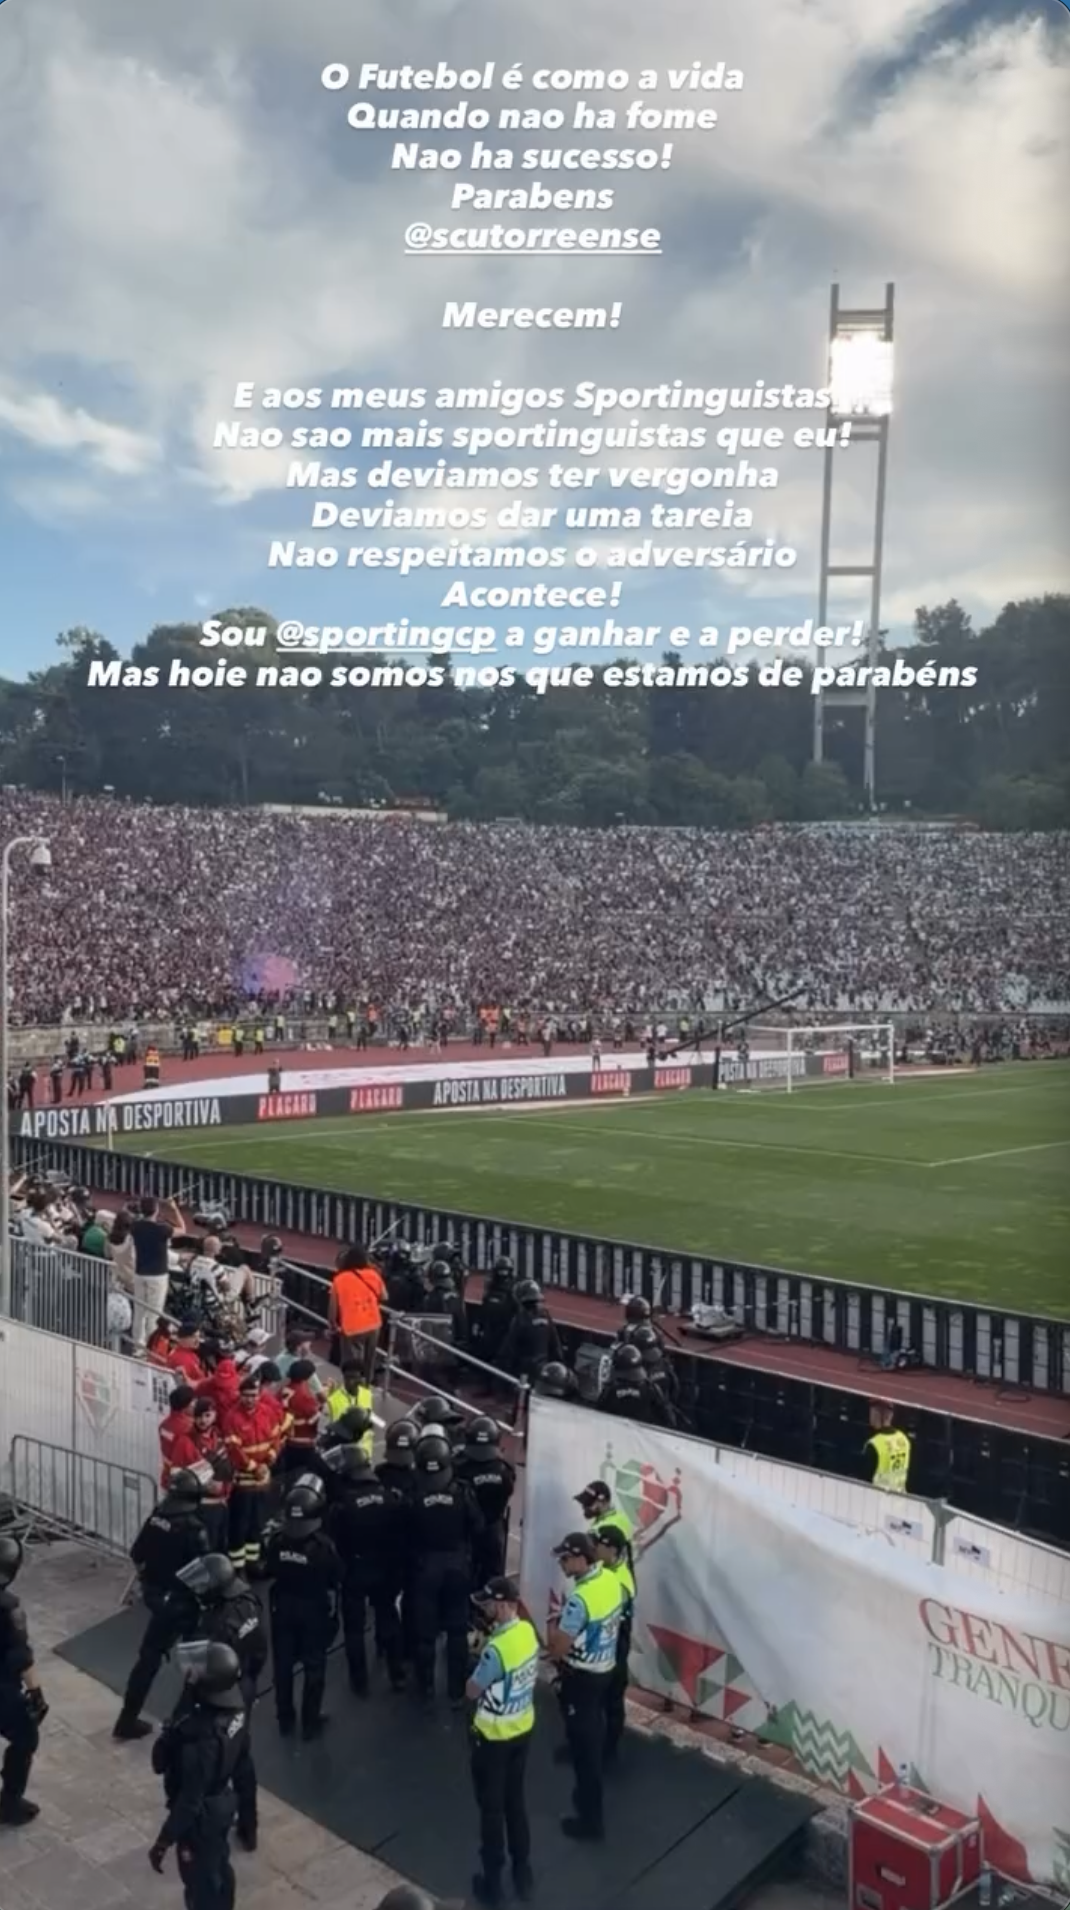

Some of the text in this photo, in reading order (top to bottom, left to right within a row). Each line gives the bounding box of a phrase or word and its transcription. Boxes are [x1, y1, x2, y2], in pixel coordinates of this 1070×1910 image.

[433, 1075, 567, 1105] APOSTA NA DESPORTIVA
[20, 1098, 222, 1138] APOSTA NA DESPORTIVA
[928, 1642, 1070, 1731] TRANQU
